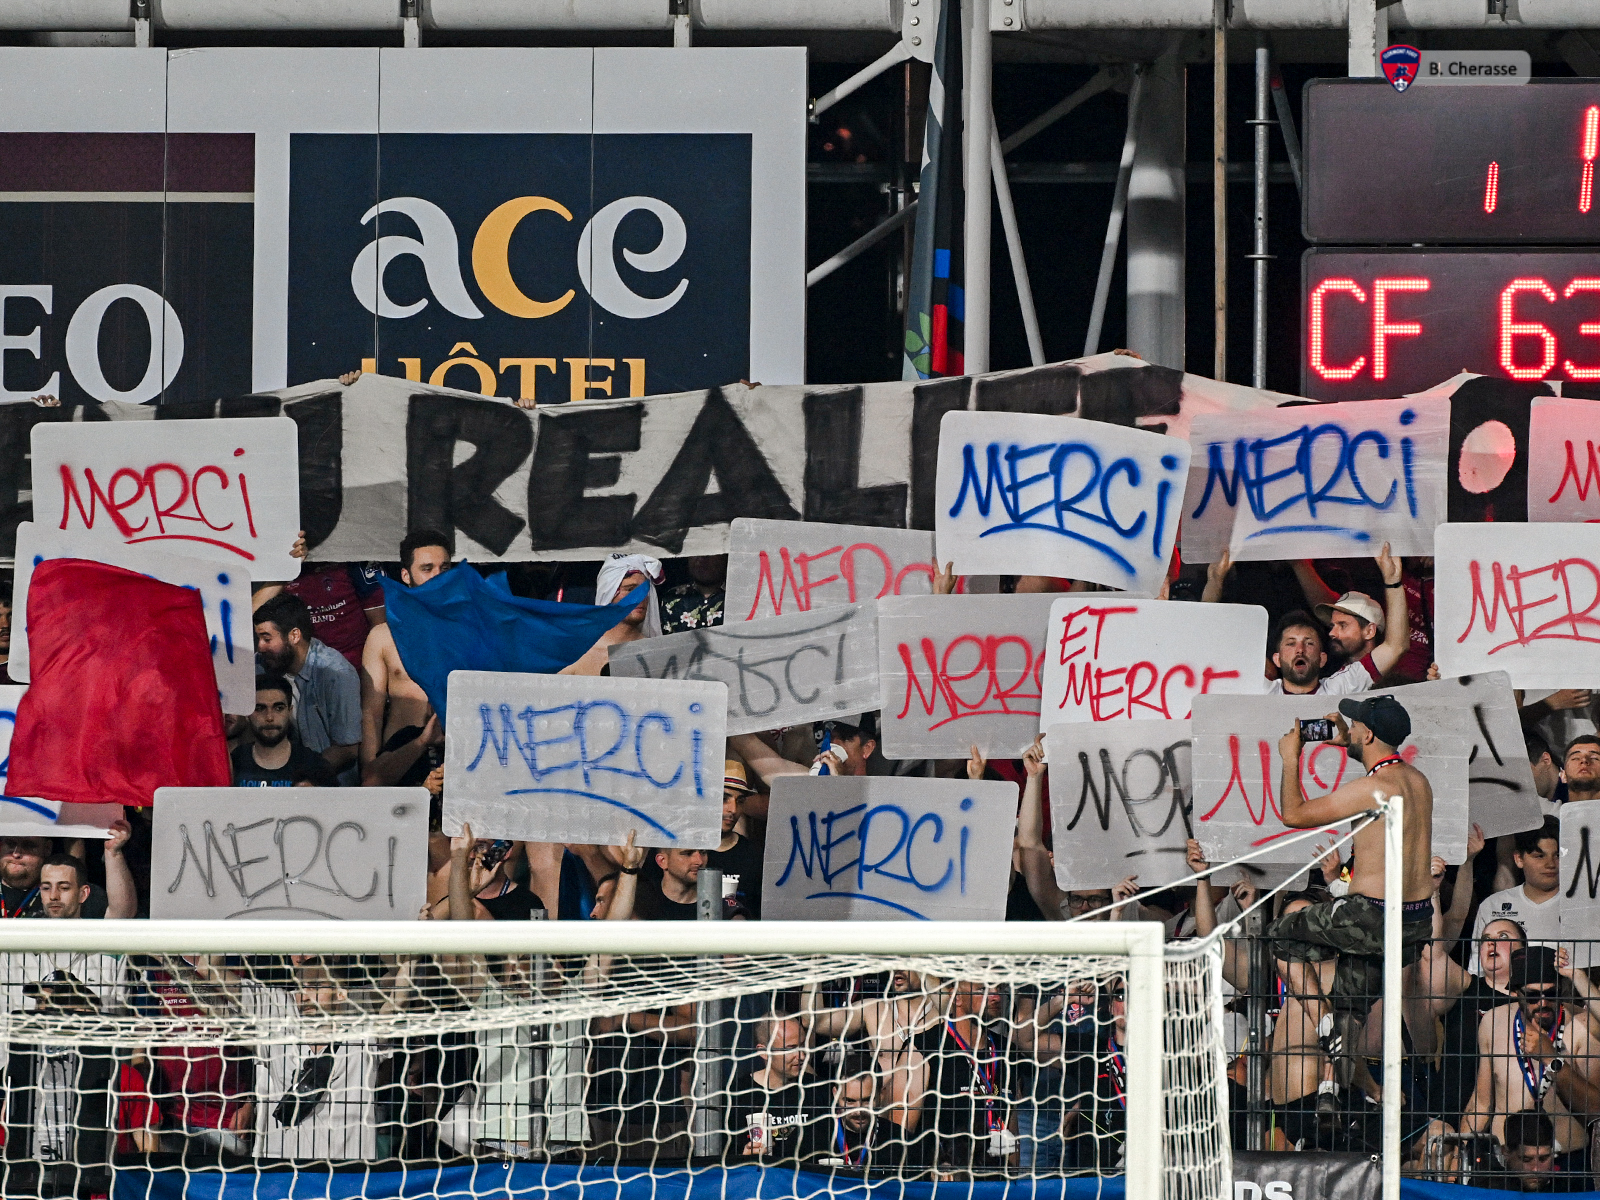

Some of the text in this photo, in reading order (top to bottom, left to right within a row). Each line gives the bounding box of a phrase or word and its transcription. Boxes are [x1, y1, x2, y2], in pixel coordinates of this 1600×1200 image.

[351, 196, 689, 319] ace
[1310, 278, 1429, 380] CF
[1060, 605, 1138, 665] ET
